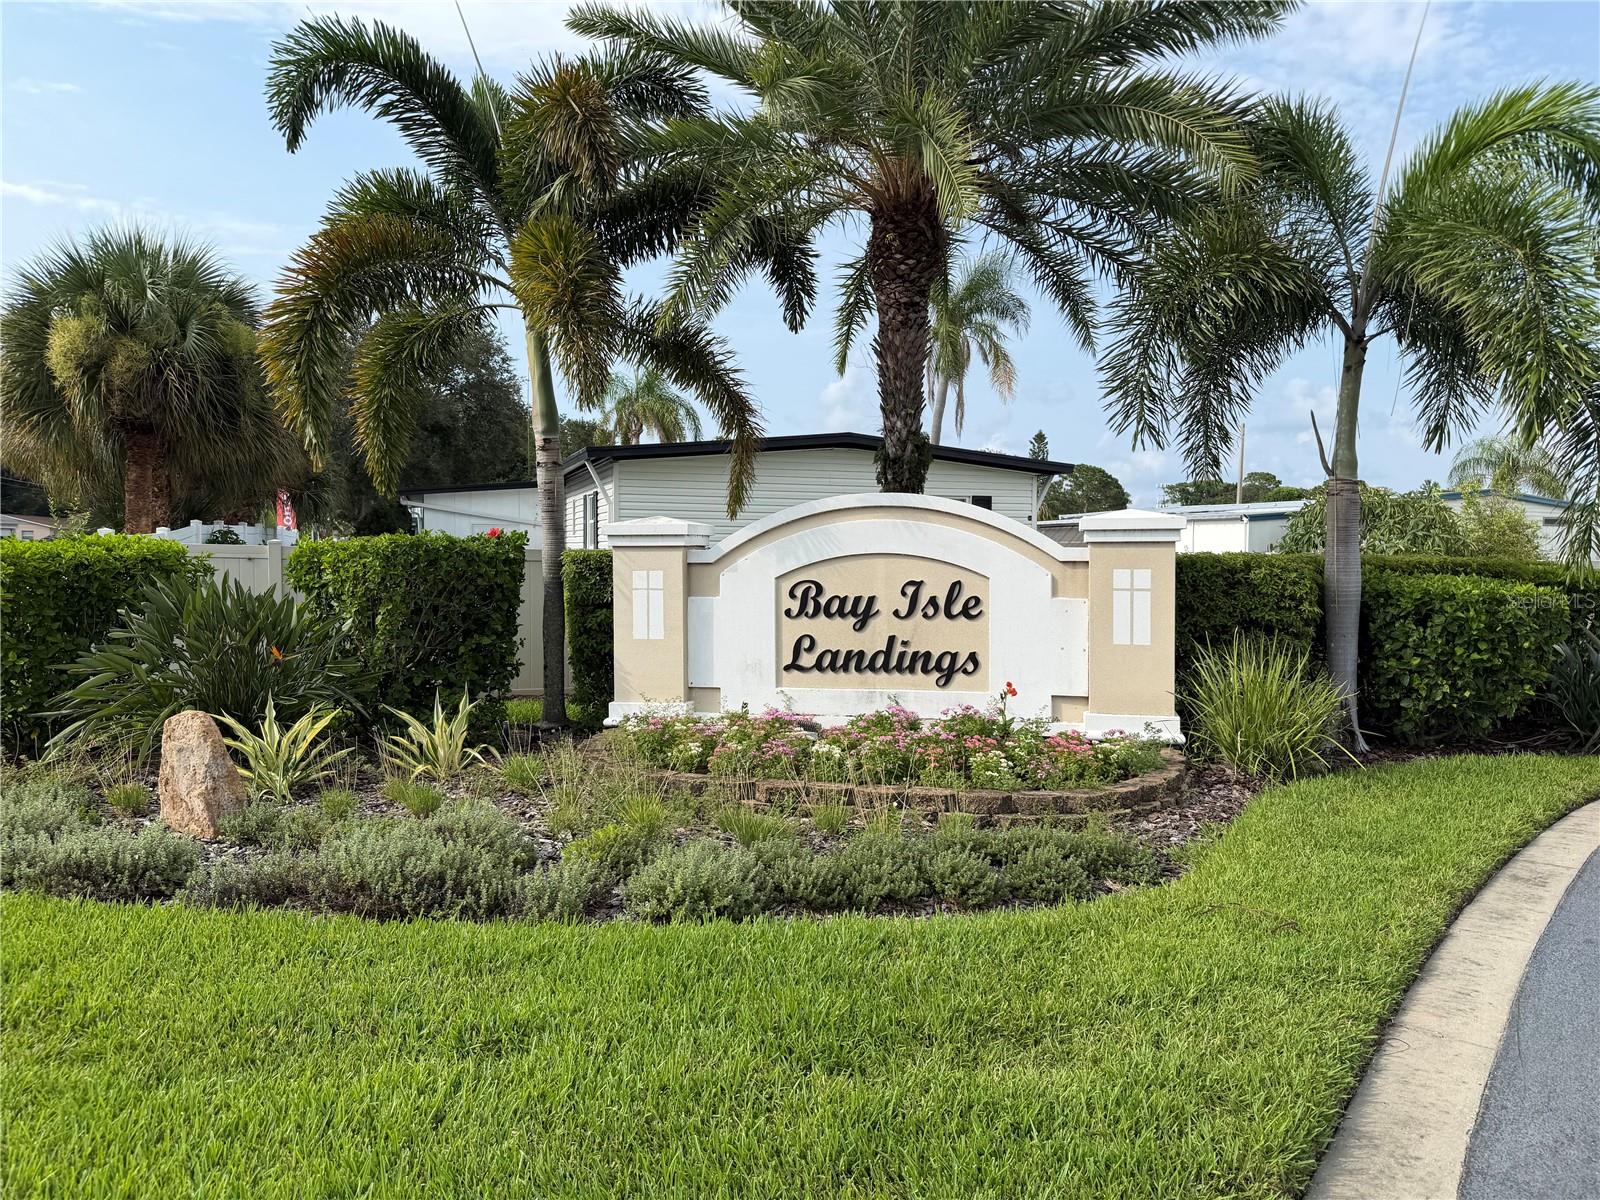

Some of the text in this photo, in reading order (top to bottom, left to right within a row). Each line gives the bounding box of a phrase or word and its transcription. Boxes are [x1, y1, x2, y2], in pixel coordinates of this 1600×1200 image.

[784, 579, 983, 632] Bay Isle
[783, 634, 980, 688] Landings
